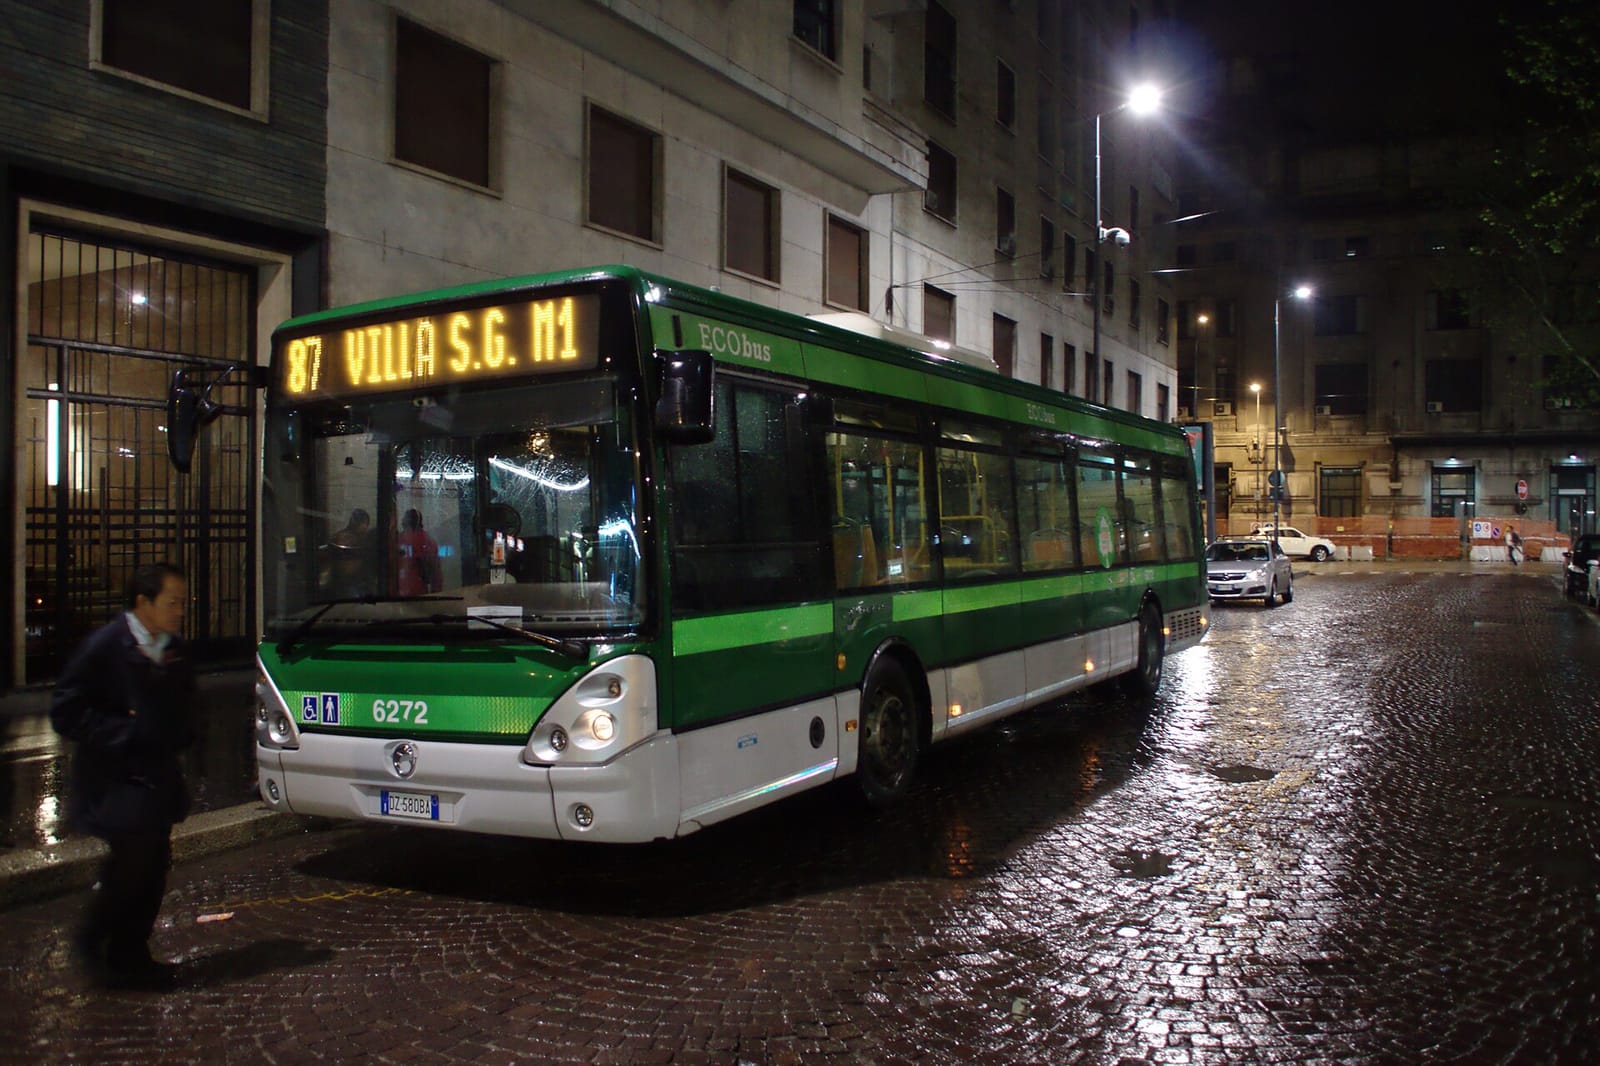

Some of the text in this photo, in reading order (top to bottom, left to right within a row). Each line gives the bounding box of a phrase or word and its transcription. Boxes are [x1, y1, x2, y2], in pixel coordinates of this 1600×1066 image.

[286, 297, 577, 393] 87 VILLA S.G. M1
[698, 323, 771, 362] ECObus
[373, 699, 428, 724] 6272
